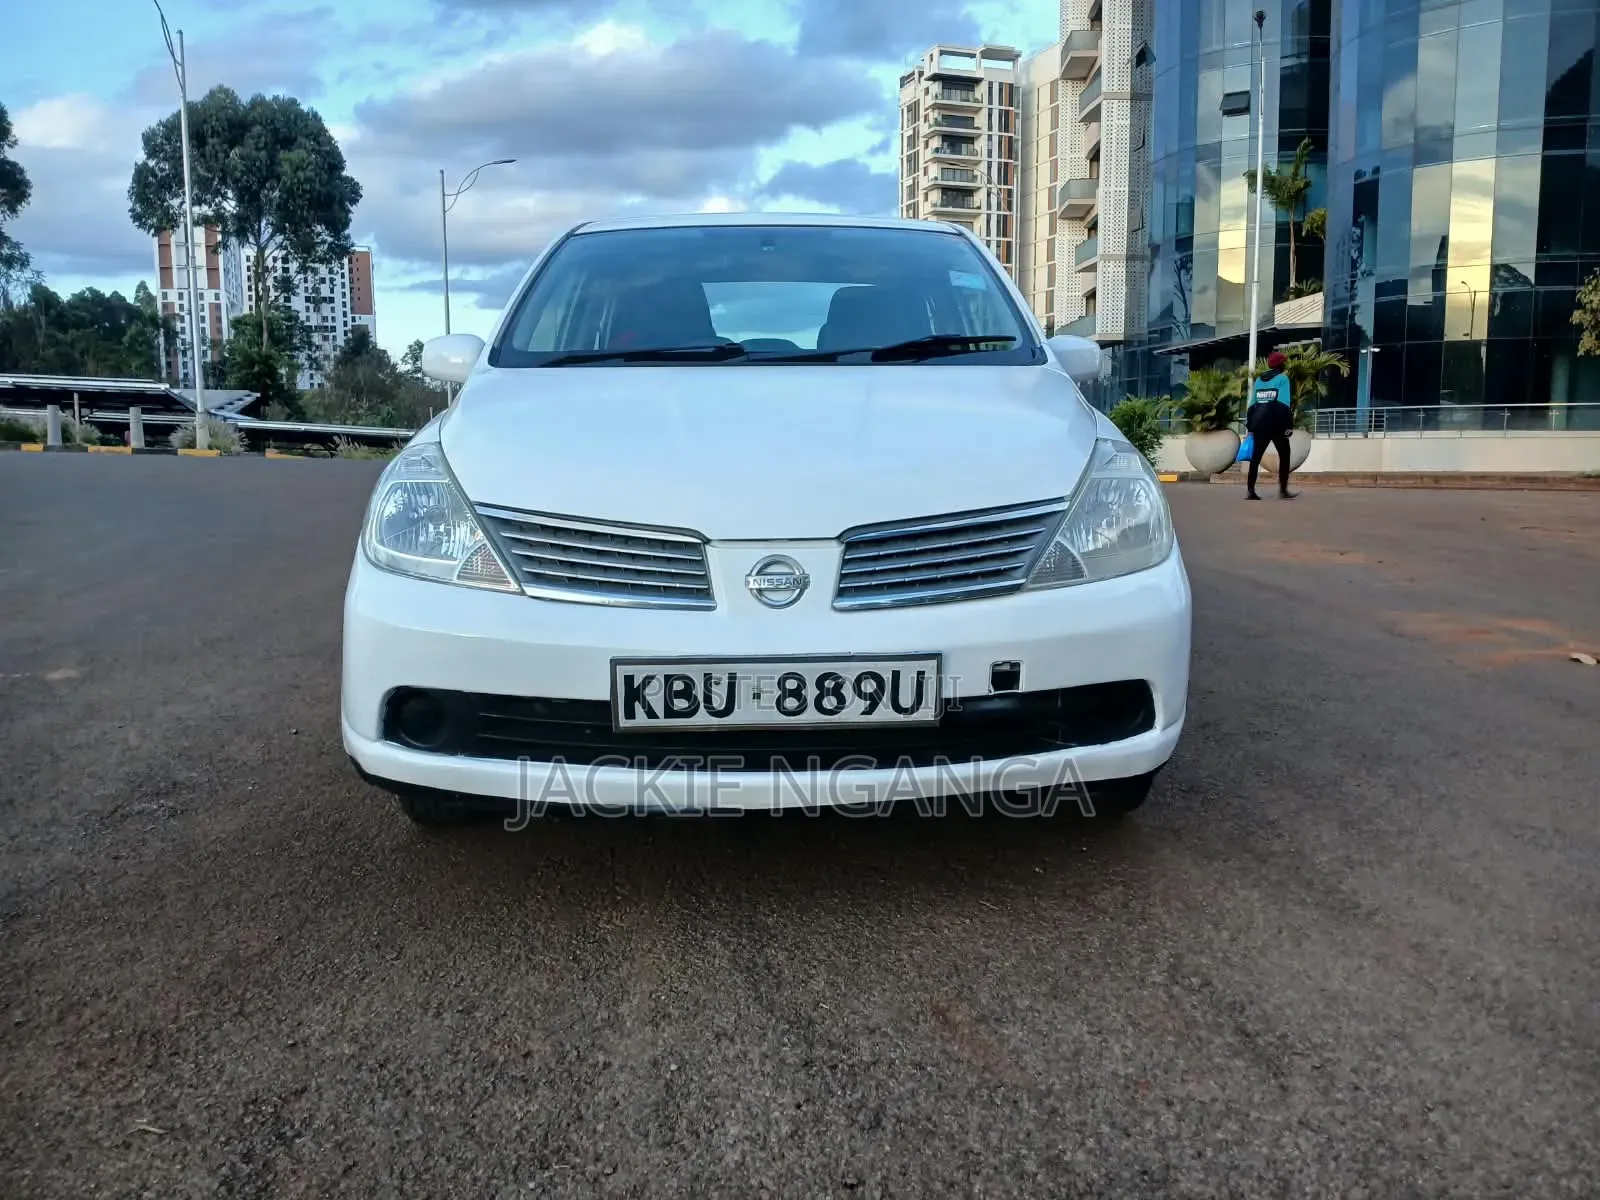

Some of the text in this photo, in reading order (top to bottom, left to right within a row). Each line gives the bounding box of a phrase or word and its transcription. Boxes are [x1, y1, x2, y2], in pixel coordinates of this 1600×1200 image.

[752, 577, 802, 587] NISSAN
[623, 670, 926, 720] KBU 889U
